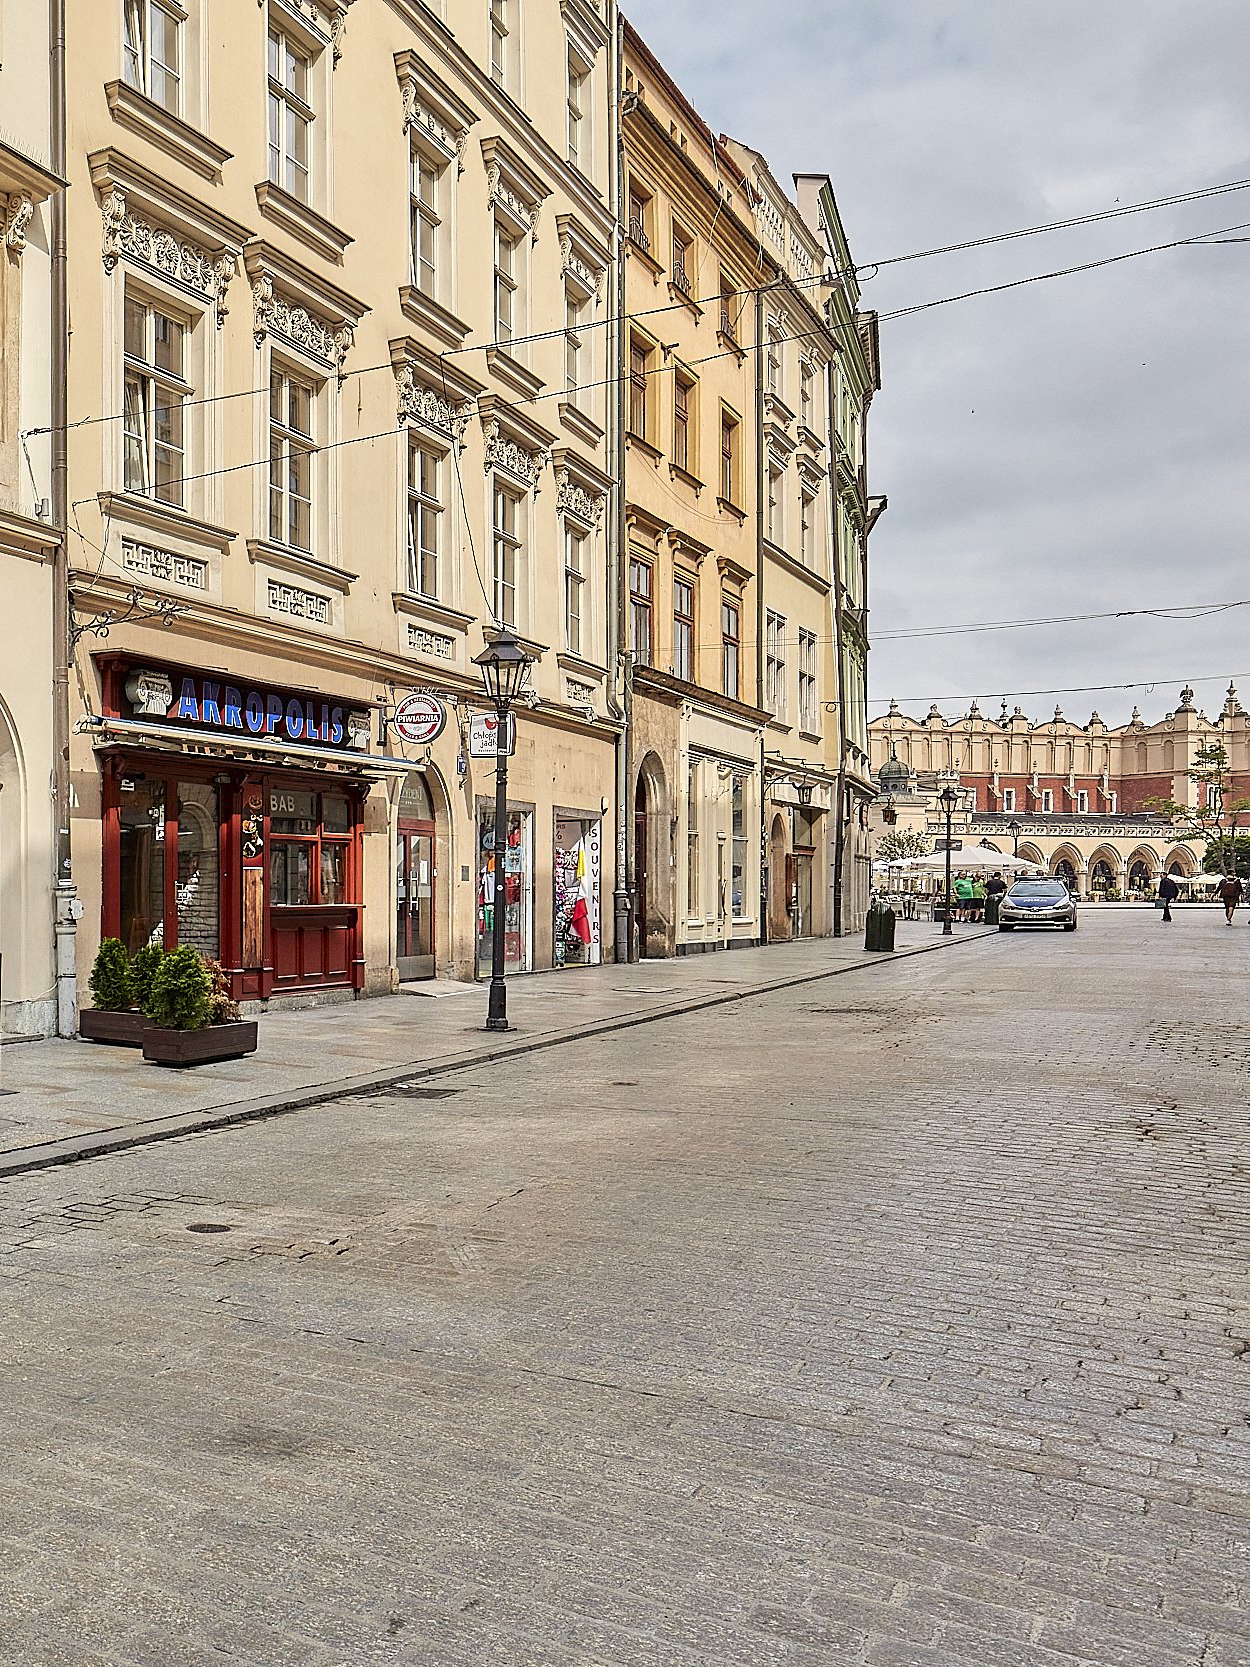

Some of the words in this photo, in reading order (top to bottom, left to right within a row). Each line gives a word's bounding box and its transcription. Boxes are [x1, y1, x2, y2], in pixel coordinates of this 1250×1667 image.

[177, 678, 343, 743] AKROPOLIS
[397, 715, 439, 723] PIWIARNIA
[590, 829, 600, 944] SOUVENIRS
